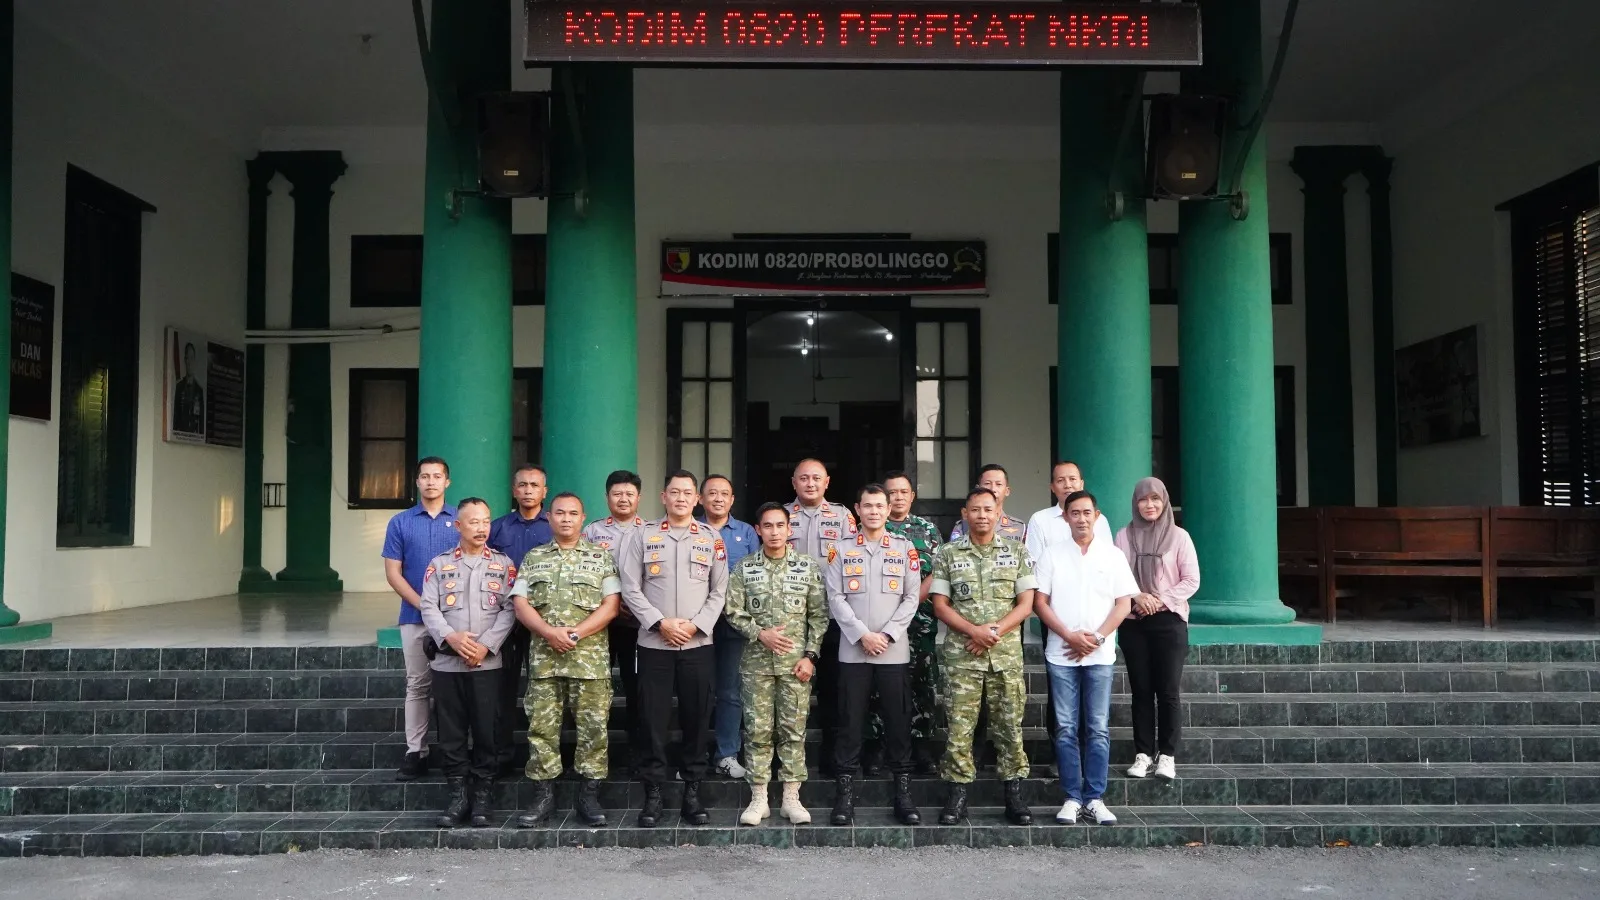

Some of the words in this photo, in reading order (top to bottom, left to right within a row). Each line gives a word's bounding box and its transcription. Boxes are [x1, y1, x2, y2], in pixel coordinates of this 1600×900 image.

[565, 11, 706, 45] KODIM
[723, 12, 825, 45] 0820
[1049, 15, 1149, 47] NKRI
[698, 253, 759, 269] KODIM
[764, 252, 949, 269] 0820/PROBOLINGGO
[20, 342, 41, 361] DAN
[11, 359, 42, 380] KHLAS
[692, 545, 712, 553] POLRI
